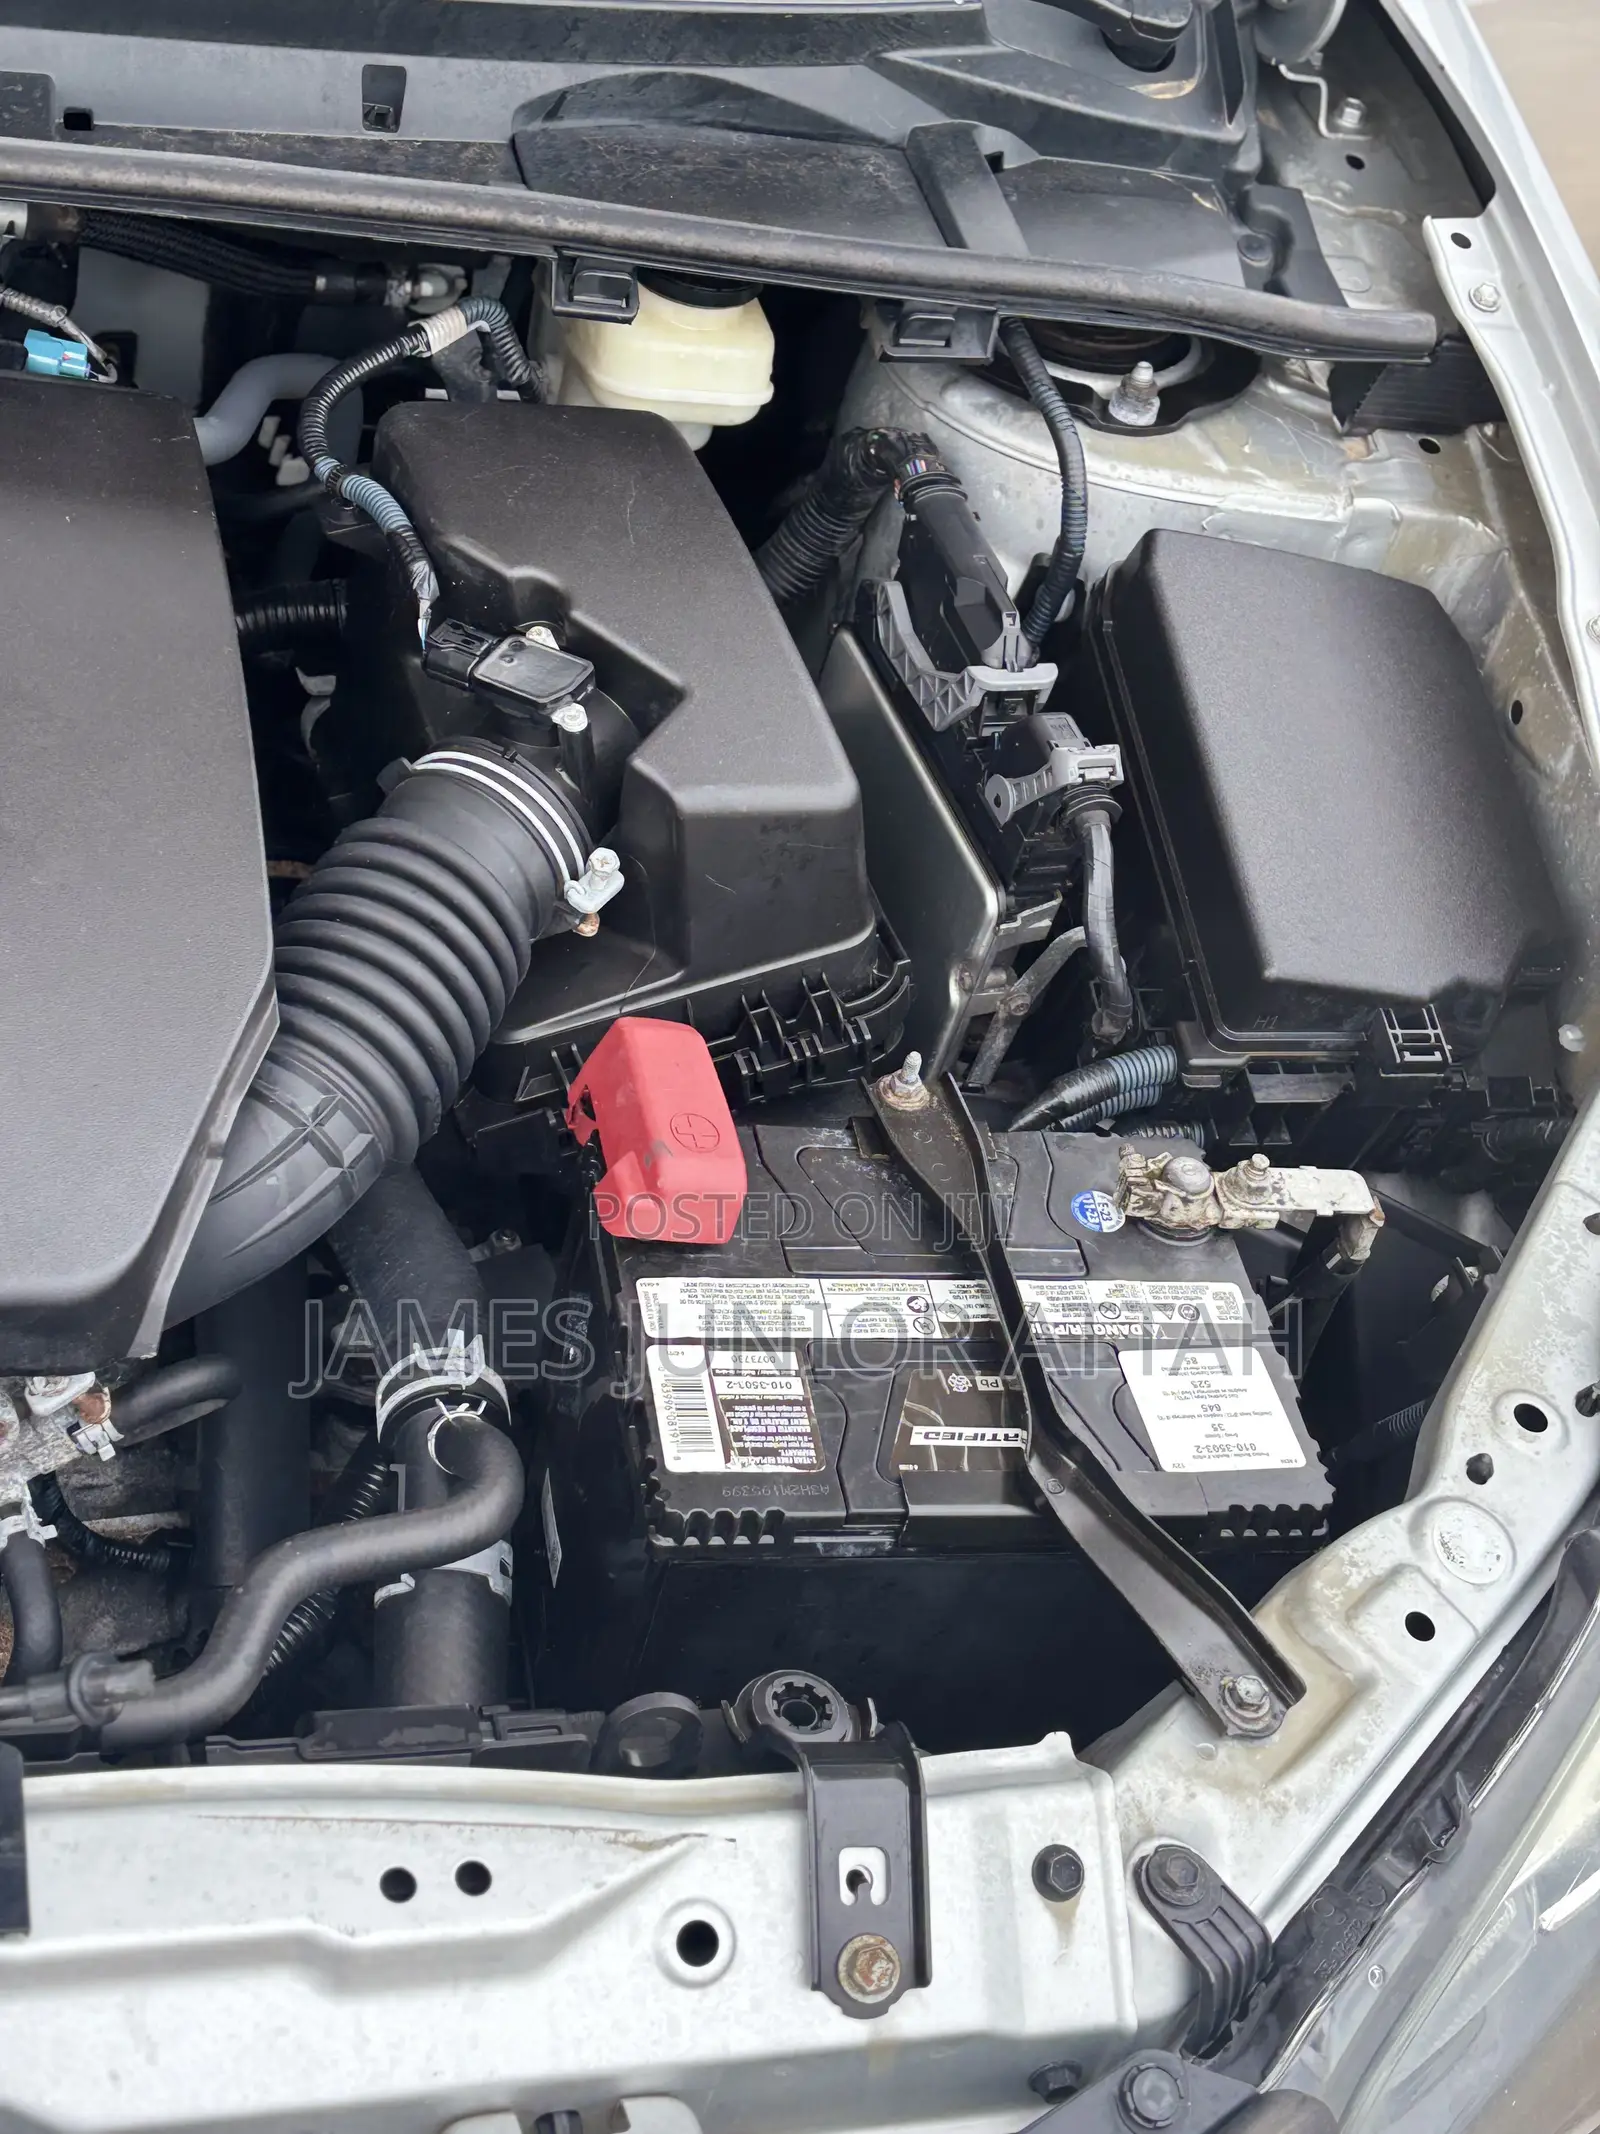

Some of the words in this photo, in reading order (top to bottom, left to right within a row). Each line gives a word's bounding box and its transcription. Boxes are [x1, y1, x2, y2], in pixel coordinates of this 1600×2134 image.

[726, 1380, 792, 1390] 010-3503-2
[981, 1378, 998, 1388] Pb
[1190, 1380, 1212, 1388] 525
[1210, 1422, 1226, 1432] 35
[1194, 1442, 1256, 1454] 010-3503-2
